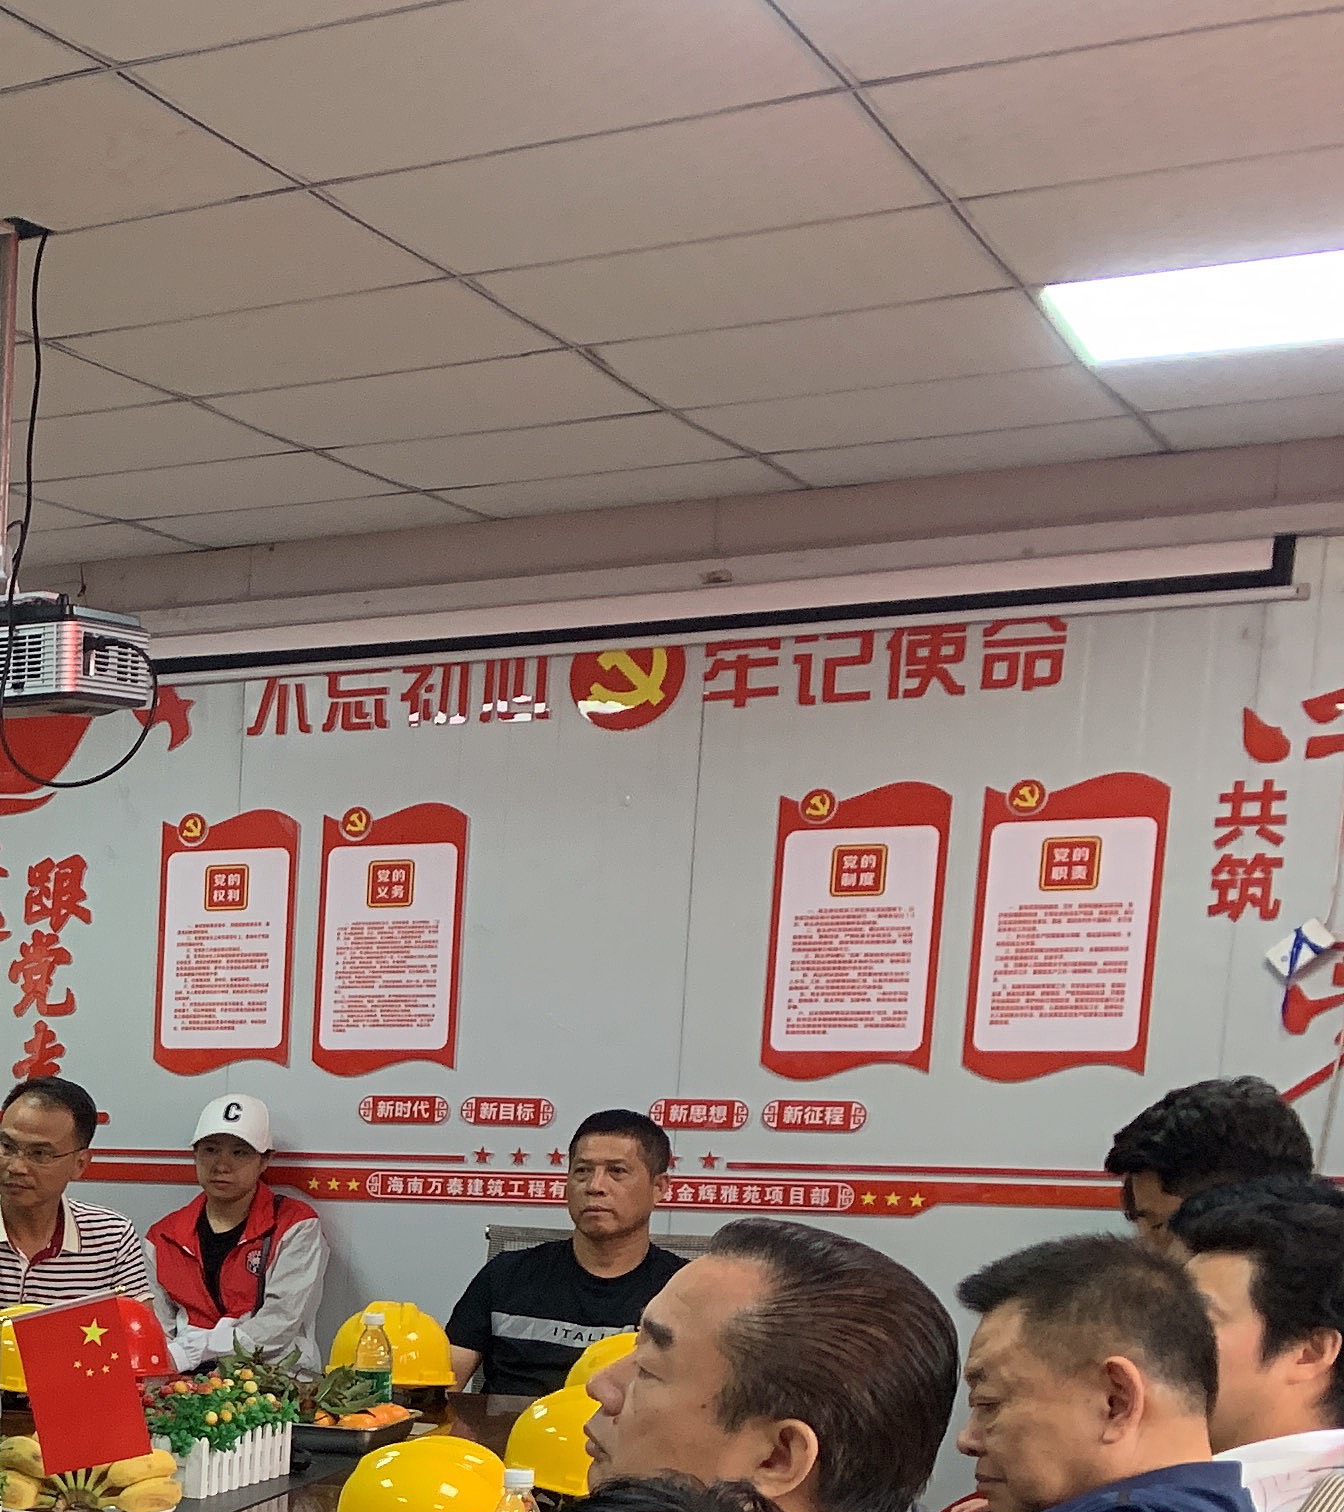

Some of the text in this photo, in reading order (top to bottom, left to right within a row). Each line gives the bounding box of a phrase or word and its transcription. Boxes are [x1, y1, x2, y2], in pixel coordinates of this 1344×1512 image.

[246, 617, 1068, 737] 不忘初心 牢记使命
[1053, 846, 1090, 863] 党的
[1207, 778, 1288, 922] 共筑
[842, 853, 878, 870] 党的
[213, 872, 242, 887] 党的
[376, 868, 407, 883] 党的
[212, 888, 241, 903] 权利
[375, 884, 405, 899] 义务
[8, 854, 92, 1080] 跟党走
[376, 1100, 431, 1120] 新时代
[478, 1102, 536, 1122] 新目标
[668, 1104, 729, 1125] 新思想
[782, 1104, 845, 1126] 新征程
[553, 1326, 606, 1343] ITALI
